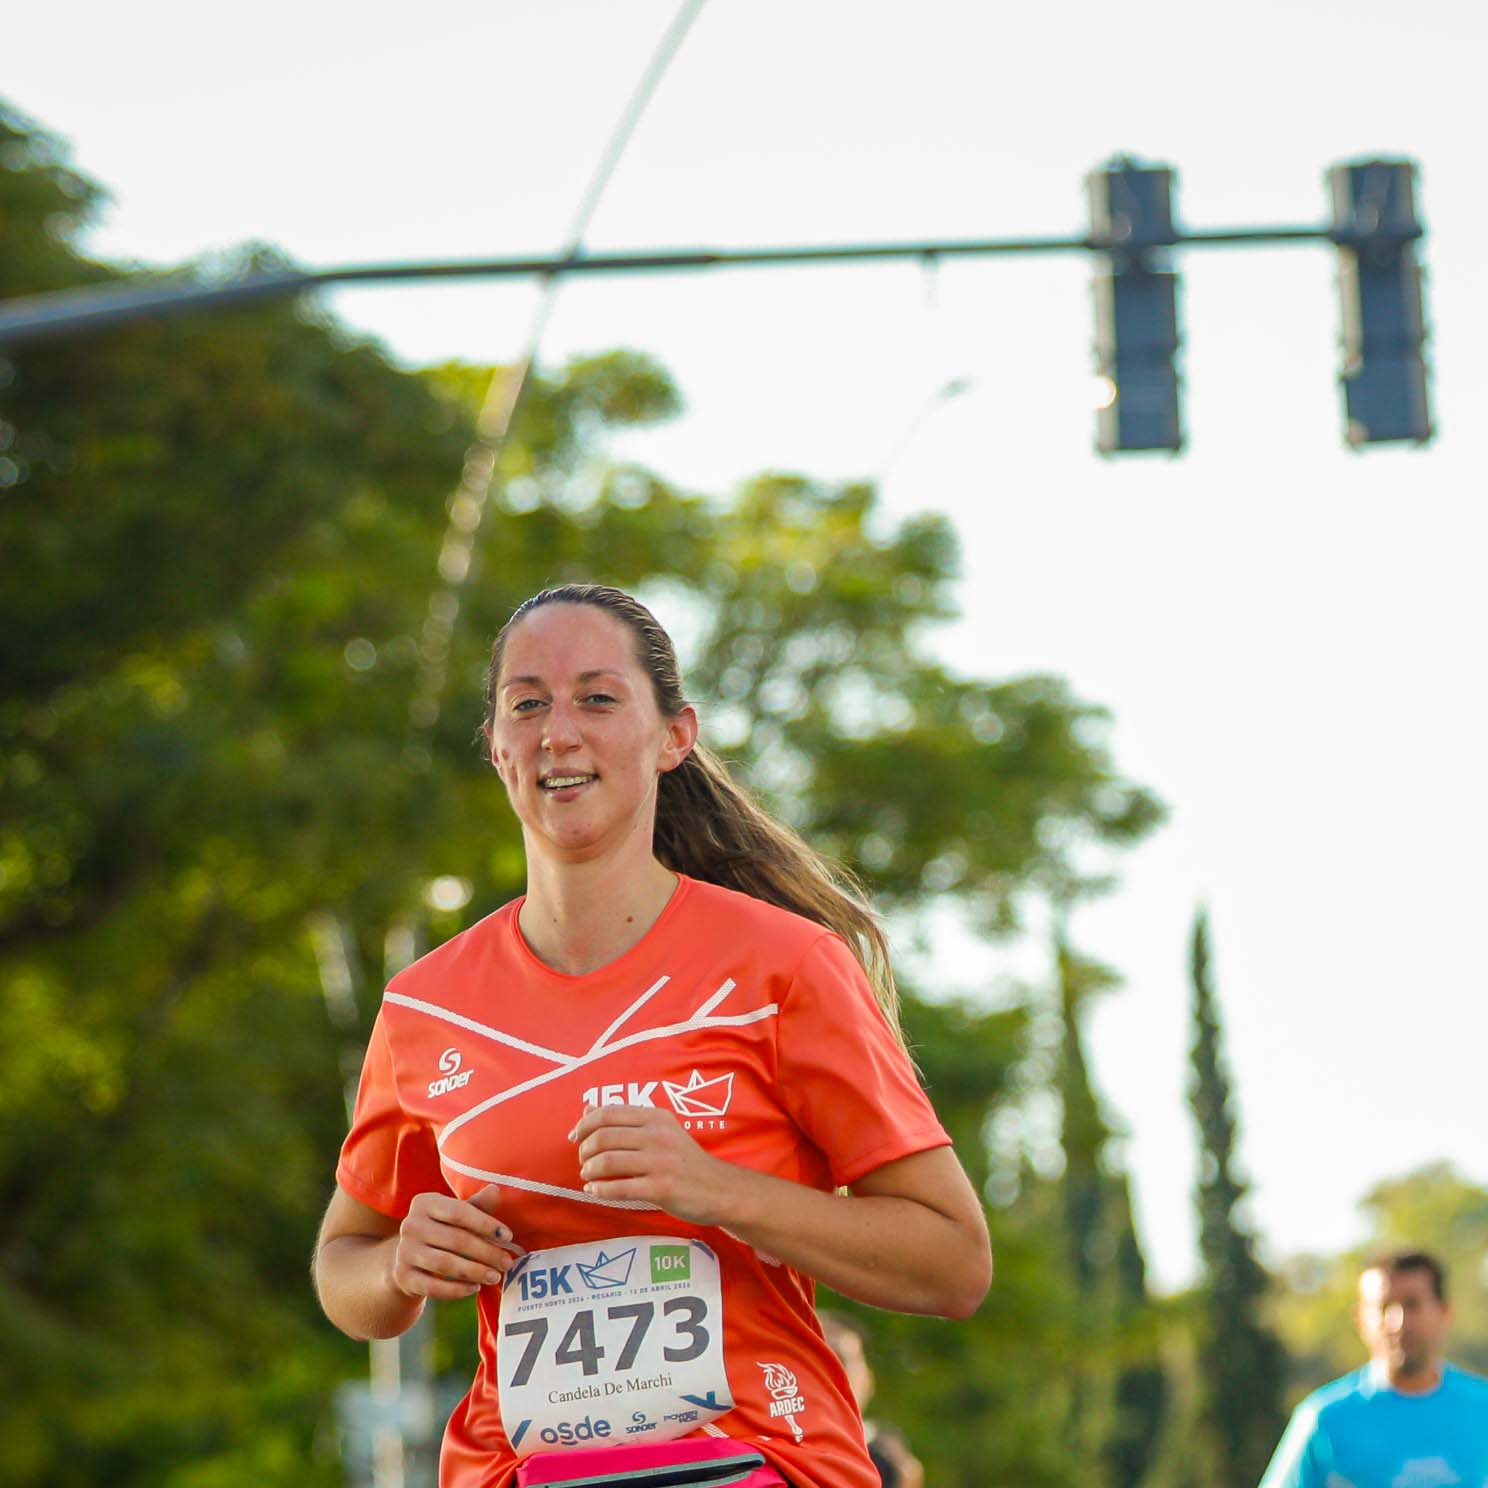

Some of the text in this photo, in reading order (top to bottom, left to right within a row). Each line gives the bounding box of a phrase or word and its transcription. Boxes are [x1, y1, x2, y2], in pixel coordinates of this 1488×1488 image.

[684, 1120, 726, 1130] ORTE
[654, 1255, 686, 1271] 10K
[517, 1264, 574, 1301] 15K
[504, 1295, 710, 1388] 7473
[548, 1371, 673, 1404] Candela De Marchi
[769, 1396, 806, 1418] ARDEC
[540, 1415, 612, 1446] osde
